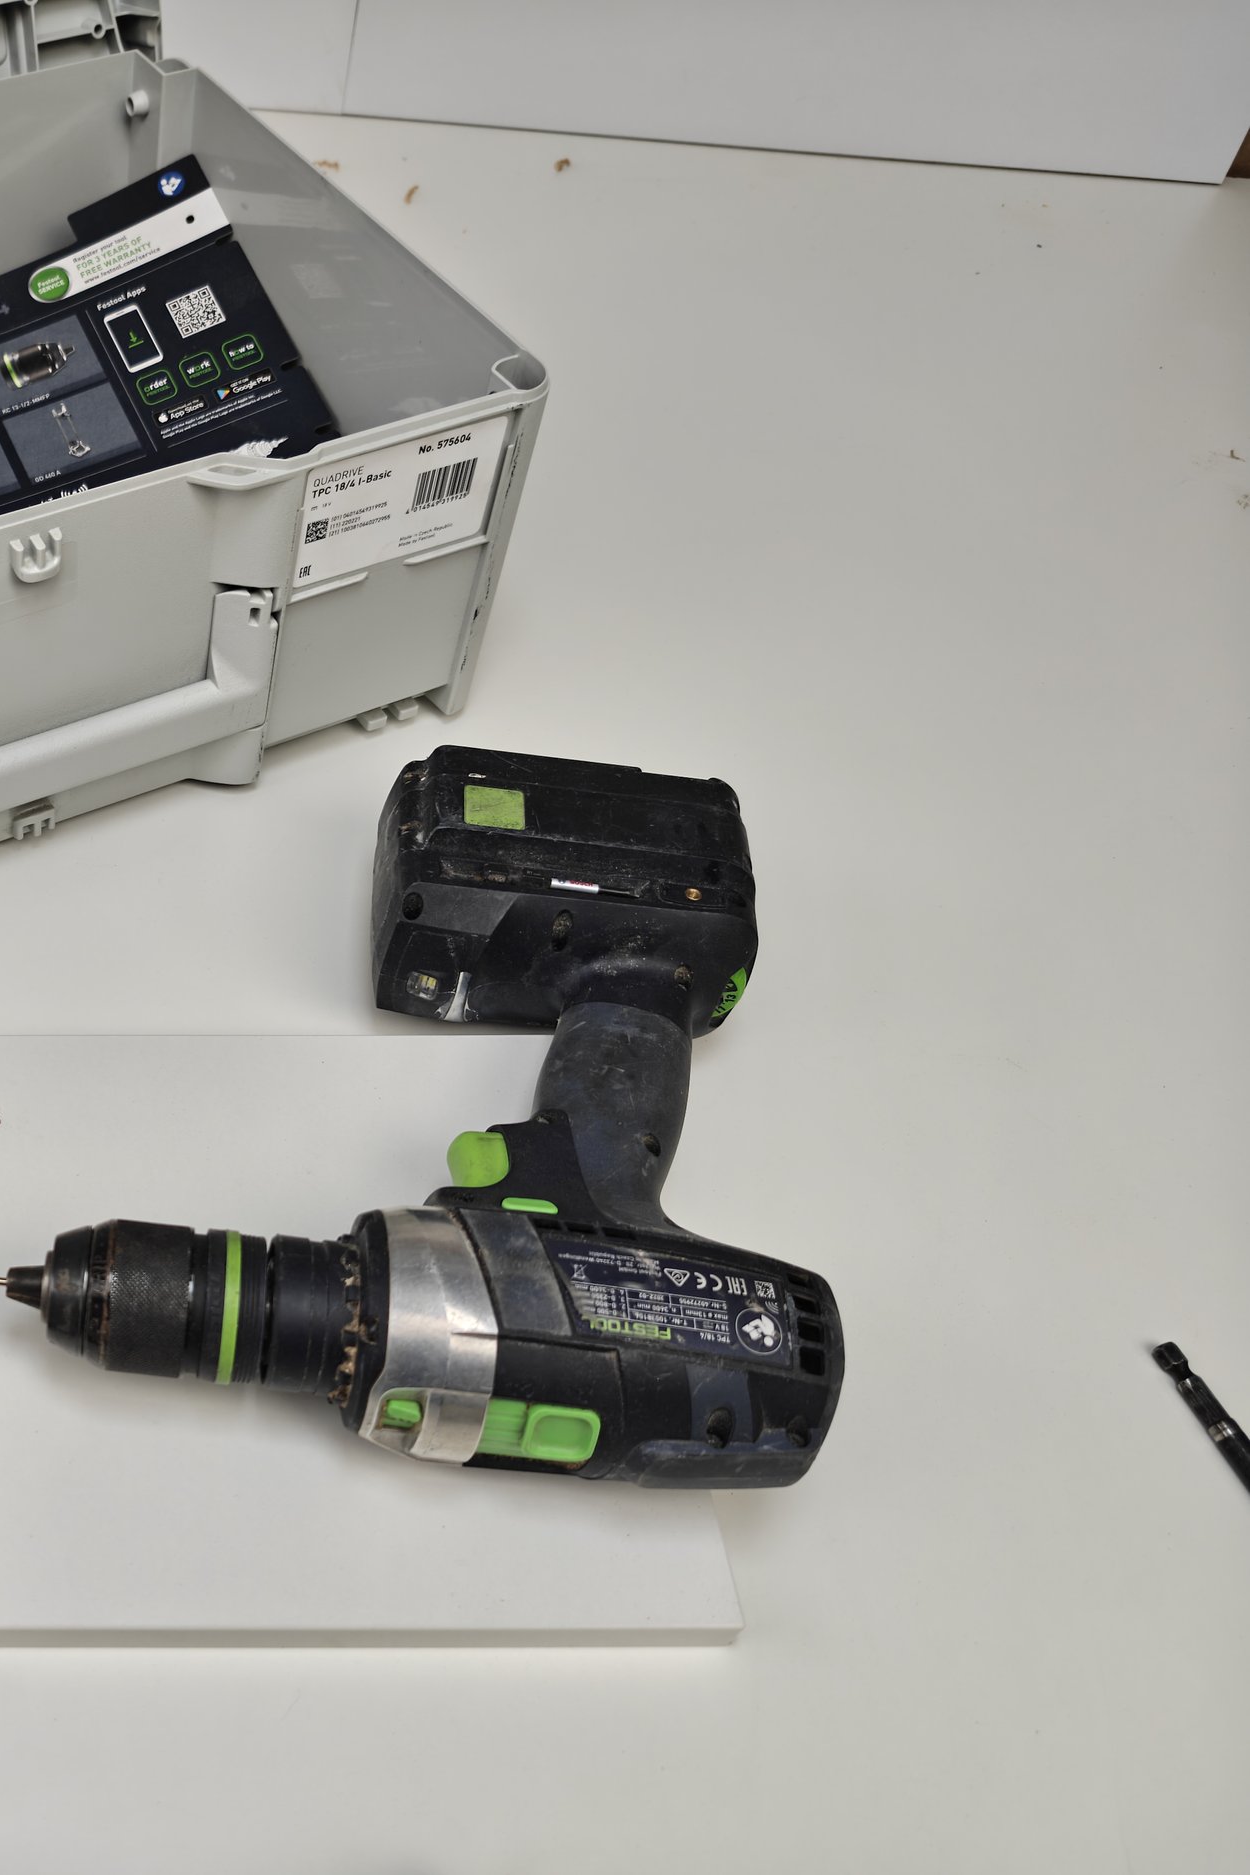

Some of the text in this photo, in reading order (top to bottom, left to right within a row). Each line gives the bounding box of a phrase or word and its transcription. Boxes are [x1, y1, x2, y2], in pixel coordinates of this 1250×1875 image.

[100, 241, 114, 252] your
[114, 235, 127, 244] tool
[76, 236, 142, 271] FOR 3 YEARS OF
[79, 241, 151, 279] FREE WARRANTY
[37, 275, 62, 289] Festool
[38, 279, 65, 295] SERVICE
[96, 286, 146, 311] Festool Apps
[228, 343, 255, 358] how to
[186, 360, 211, 375] work
[144, 378, 168, 392] order
[232, 375, 271, 394] Google Play
[170, 402, 204, 420] App Store
[418, 432, 471, 455] No. 575604
[312, 470, 392, 499] TPC 18/4 I-Basic
[313, 465, 364, 488] QUADRIVE
[418, 528, 433, 537] Czech
[433, 523, 453, 532] Republic
[685, 1309, 707, 1318] 13mm
[580, 1316, 673, 1340] FESTOOL
[715, 1323, 721, 1331] V
[699, 1331, 731, 1343] TPC 18/4
